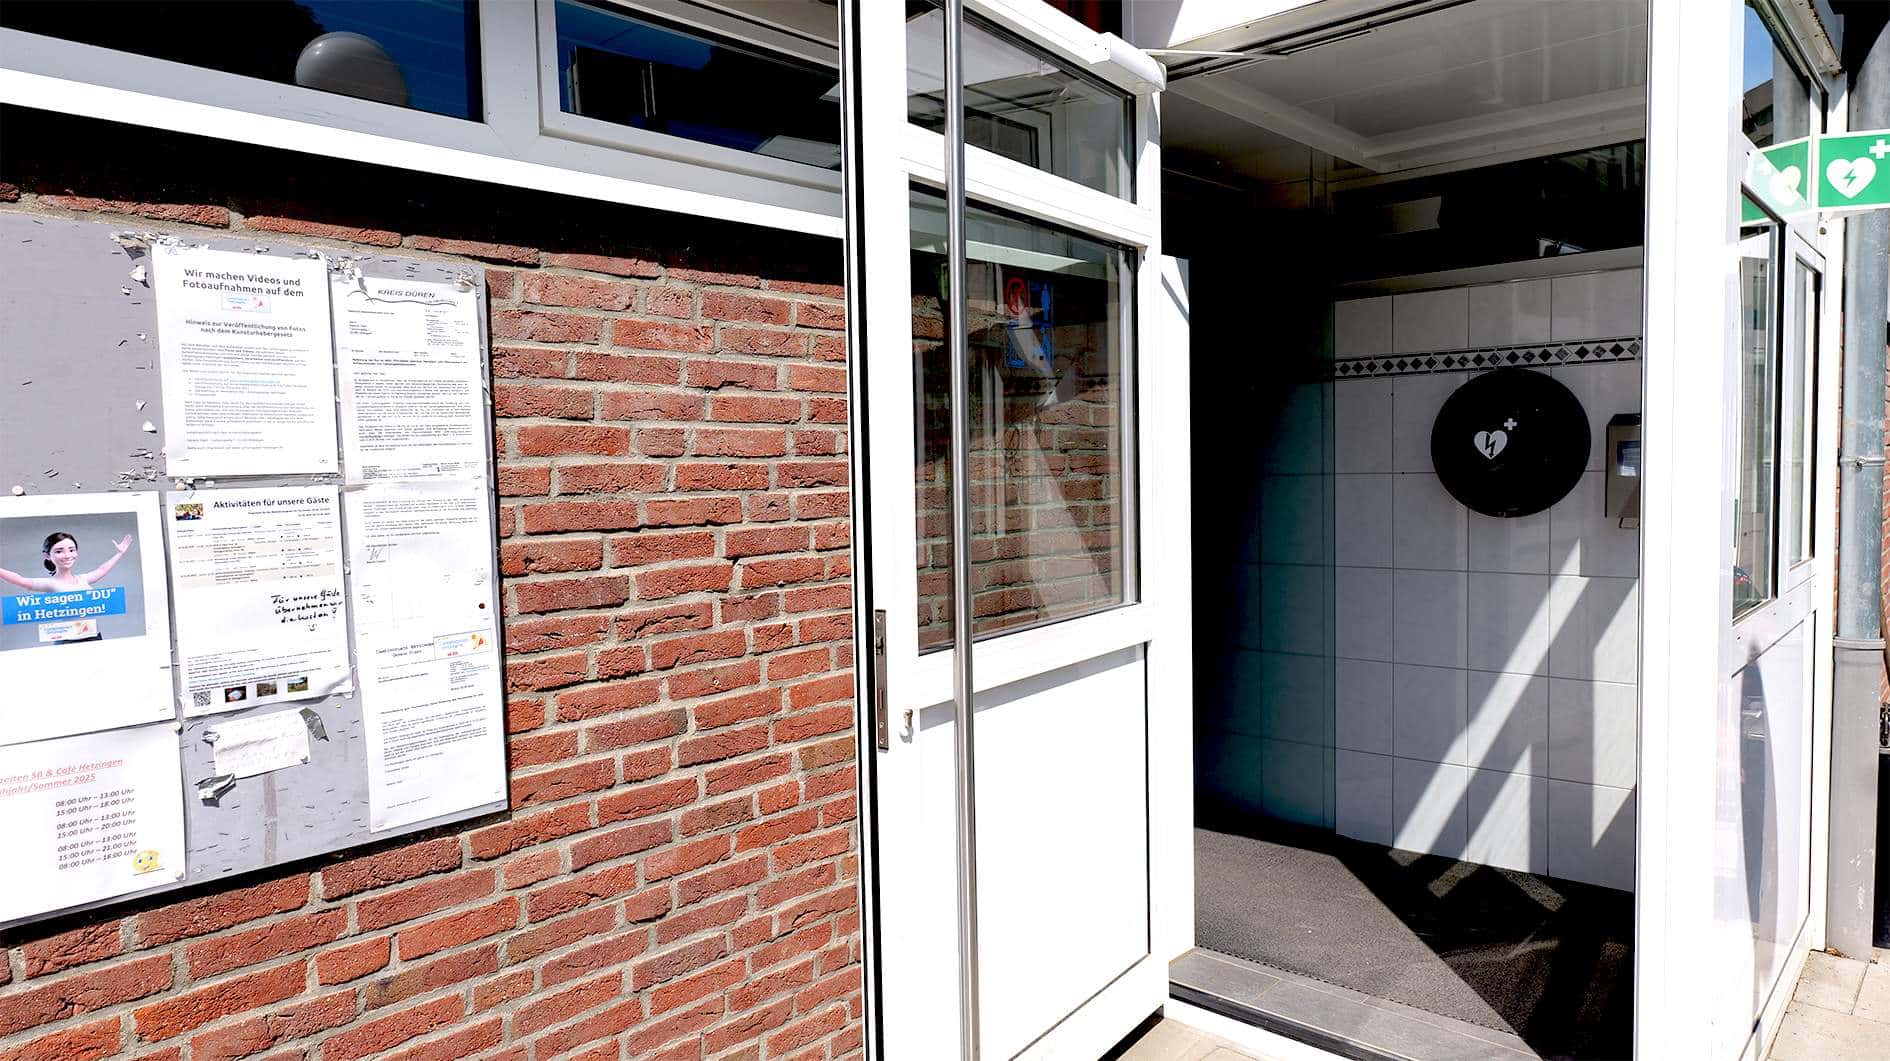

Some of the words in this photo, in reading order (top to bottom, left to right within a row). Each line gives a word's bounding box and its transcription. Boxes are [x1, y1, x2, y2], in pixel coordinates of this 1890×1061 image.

[184, 269, 202, 277] Wir
[206, 272, 244, 282] machen
[247, 274, 281, 285] Videos
[284, 278, 300, 286] und
[183, 280, 262, 294] Fotoaufnahmen
[266, 287, 281, 296] auf
[284, 289, 303, 297] dem
[405, 290, 435, 298] DÜREN
[214, 500, 261, 509] Aktivitäten
[263, 498, 275, 506] für
[16, 595, 41, 606] Wir
[45, 592, 82, 605] sagen
[86, 588, 116, 600] "DU"
[18, 610, 31, 621] in
[35, 604, 106, 619] Hetzingen!
[79, 759, 123, 771] Hetzingen
[74, 773, 96, 783] 2025
[56, 798, 76, 807] 08:00
[78, 795, 91, 803] Uhr
[100, 790, 119, 799] 13:00
[121, 788, 134, 796] Uhr
[56, 807, 77, 816] 15:00
[79, 804, 92, 812] Uhr
[57, 821, 77, 830] 08:00
[101, 812, 120, 821] 13:00
[122, 810, 135, 818] Uhr
[57, 830, 78, 839] 15:00
[80, 827, 93, 835] Uhr
[101, 821, 121, 830] 20:00
[58, 843, 78, 852] 08:00
[81, 840, 94, 848] Uhr
[102, 834, 121, 843] 13:00
[59, 852, 79, 861] 15:00
[81, 849, 94, 857] Uhr
[102, 843, 122, 852] 21:00
[124, 840, 136, 848] Uhr
[59, 861, 80, 870] 08:00
[82, 857, 95, 865] Uhr
[124, 849, 137, 857] Uhr
